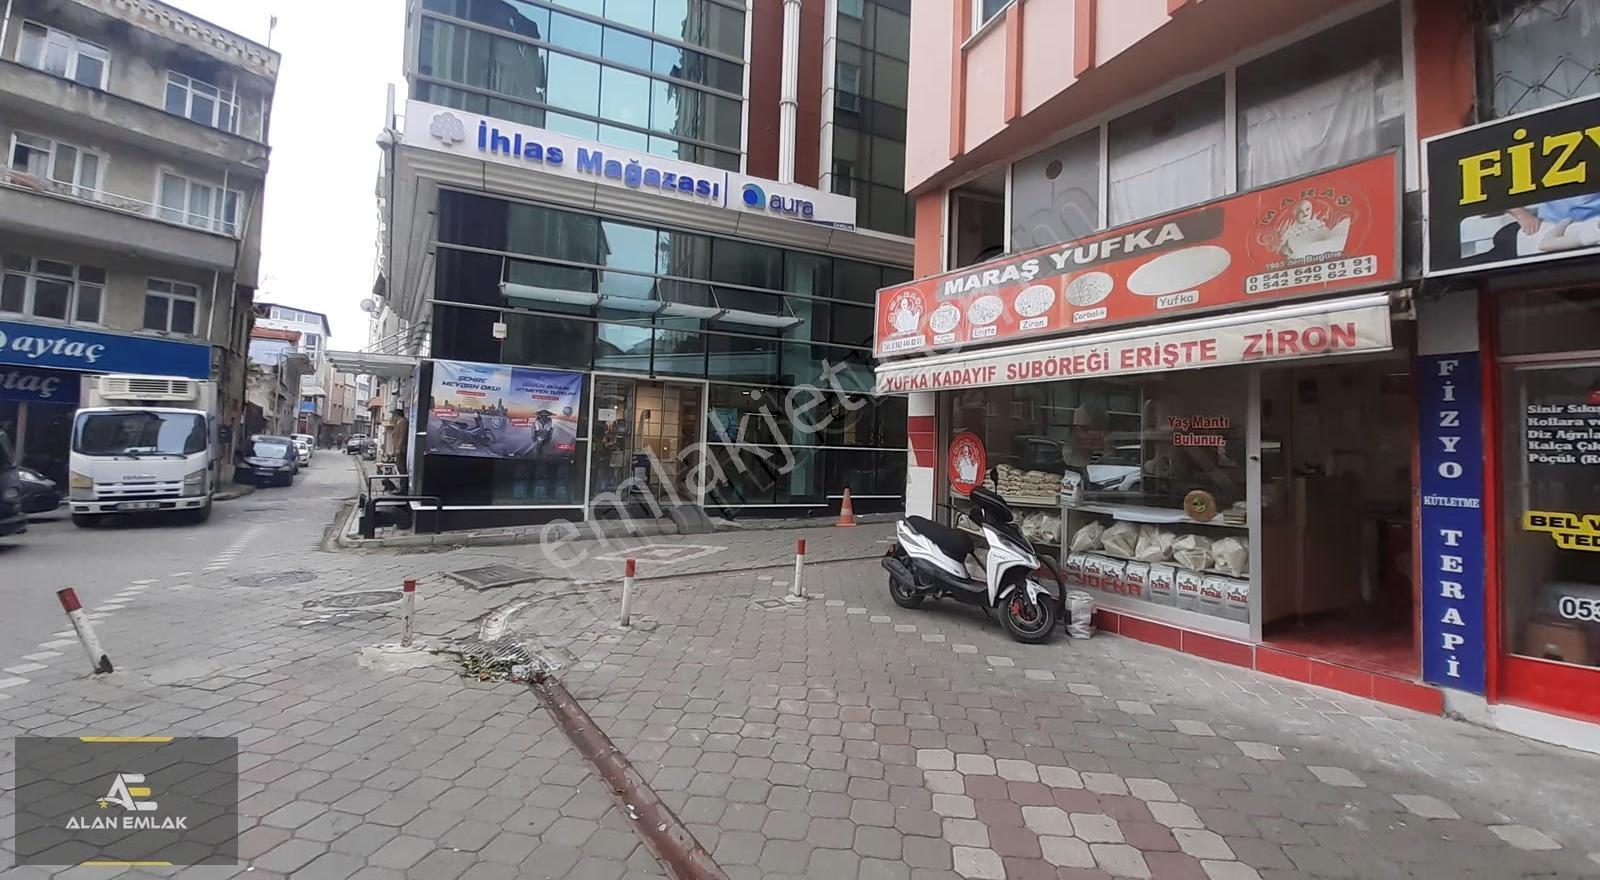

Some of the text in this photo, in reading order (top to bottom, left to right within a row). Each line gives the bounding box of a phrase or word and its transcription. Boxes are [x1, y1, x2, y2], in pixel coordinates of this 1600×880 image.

[477, 120, 718, 199] İhlas Mağazası
[770, 192, 814, 218] aura
[944, 222, 1184, 295] MARAŞ YUFKA
[1250, 257, 1372, 284] 0 544 640 01 91
[1250, 265, 1372, 292] 0 542 575 62 61
[1158, 294, 1194, 306] Yufka
[1022, 319, 1045, 328] Ziron
[12, 336, 105, 363] aytaç
[886, 322, 1356, 392] YUFKA KADAYIF SUBÖREĞİ ERİŞTE ZİRON
[0, 371, 60, 398] taç
[1528, 405, 1564, 414] Sinir
[1167, 415, 1230, 431] Yaş Mantı
[1437, 360, 1463, 479] FİZYO
[1527, 417, 1585, 427] Kollara
[1173, 432, 1226, 447] Bulunur.
[1527, 430, 1553, 439] Diz
[1528, 441, 1573, 452] Kalça
[1528, 453, 1576, 465] Pöçük
[1423, 493, 1480, 508] KÜTLETME
[1530, 515, 1580, 529] BEL
[1440, 529, 1465, 678] TERAPİ
